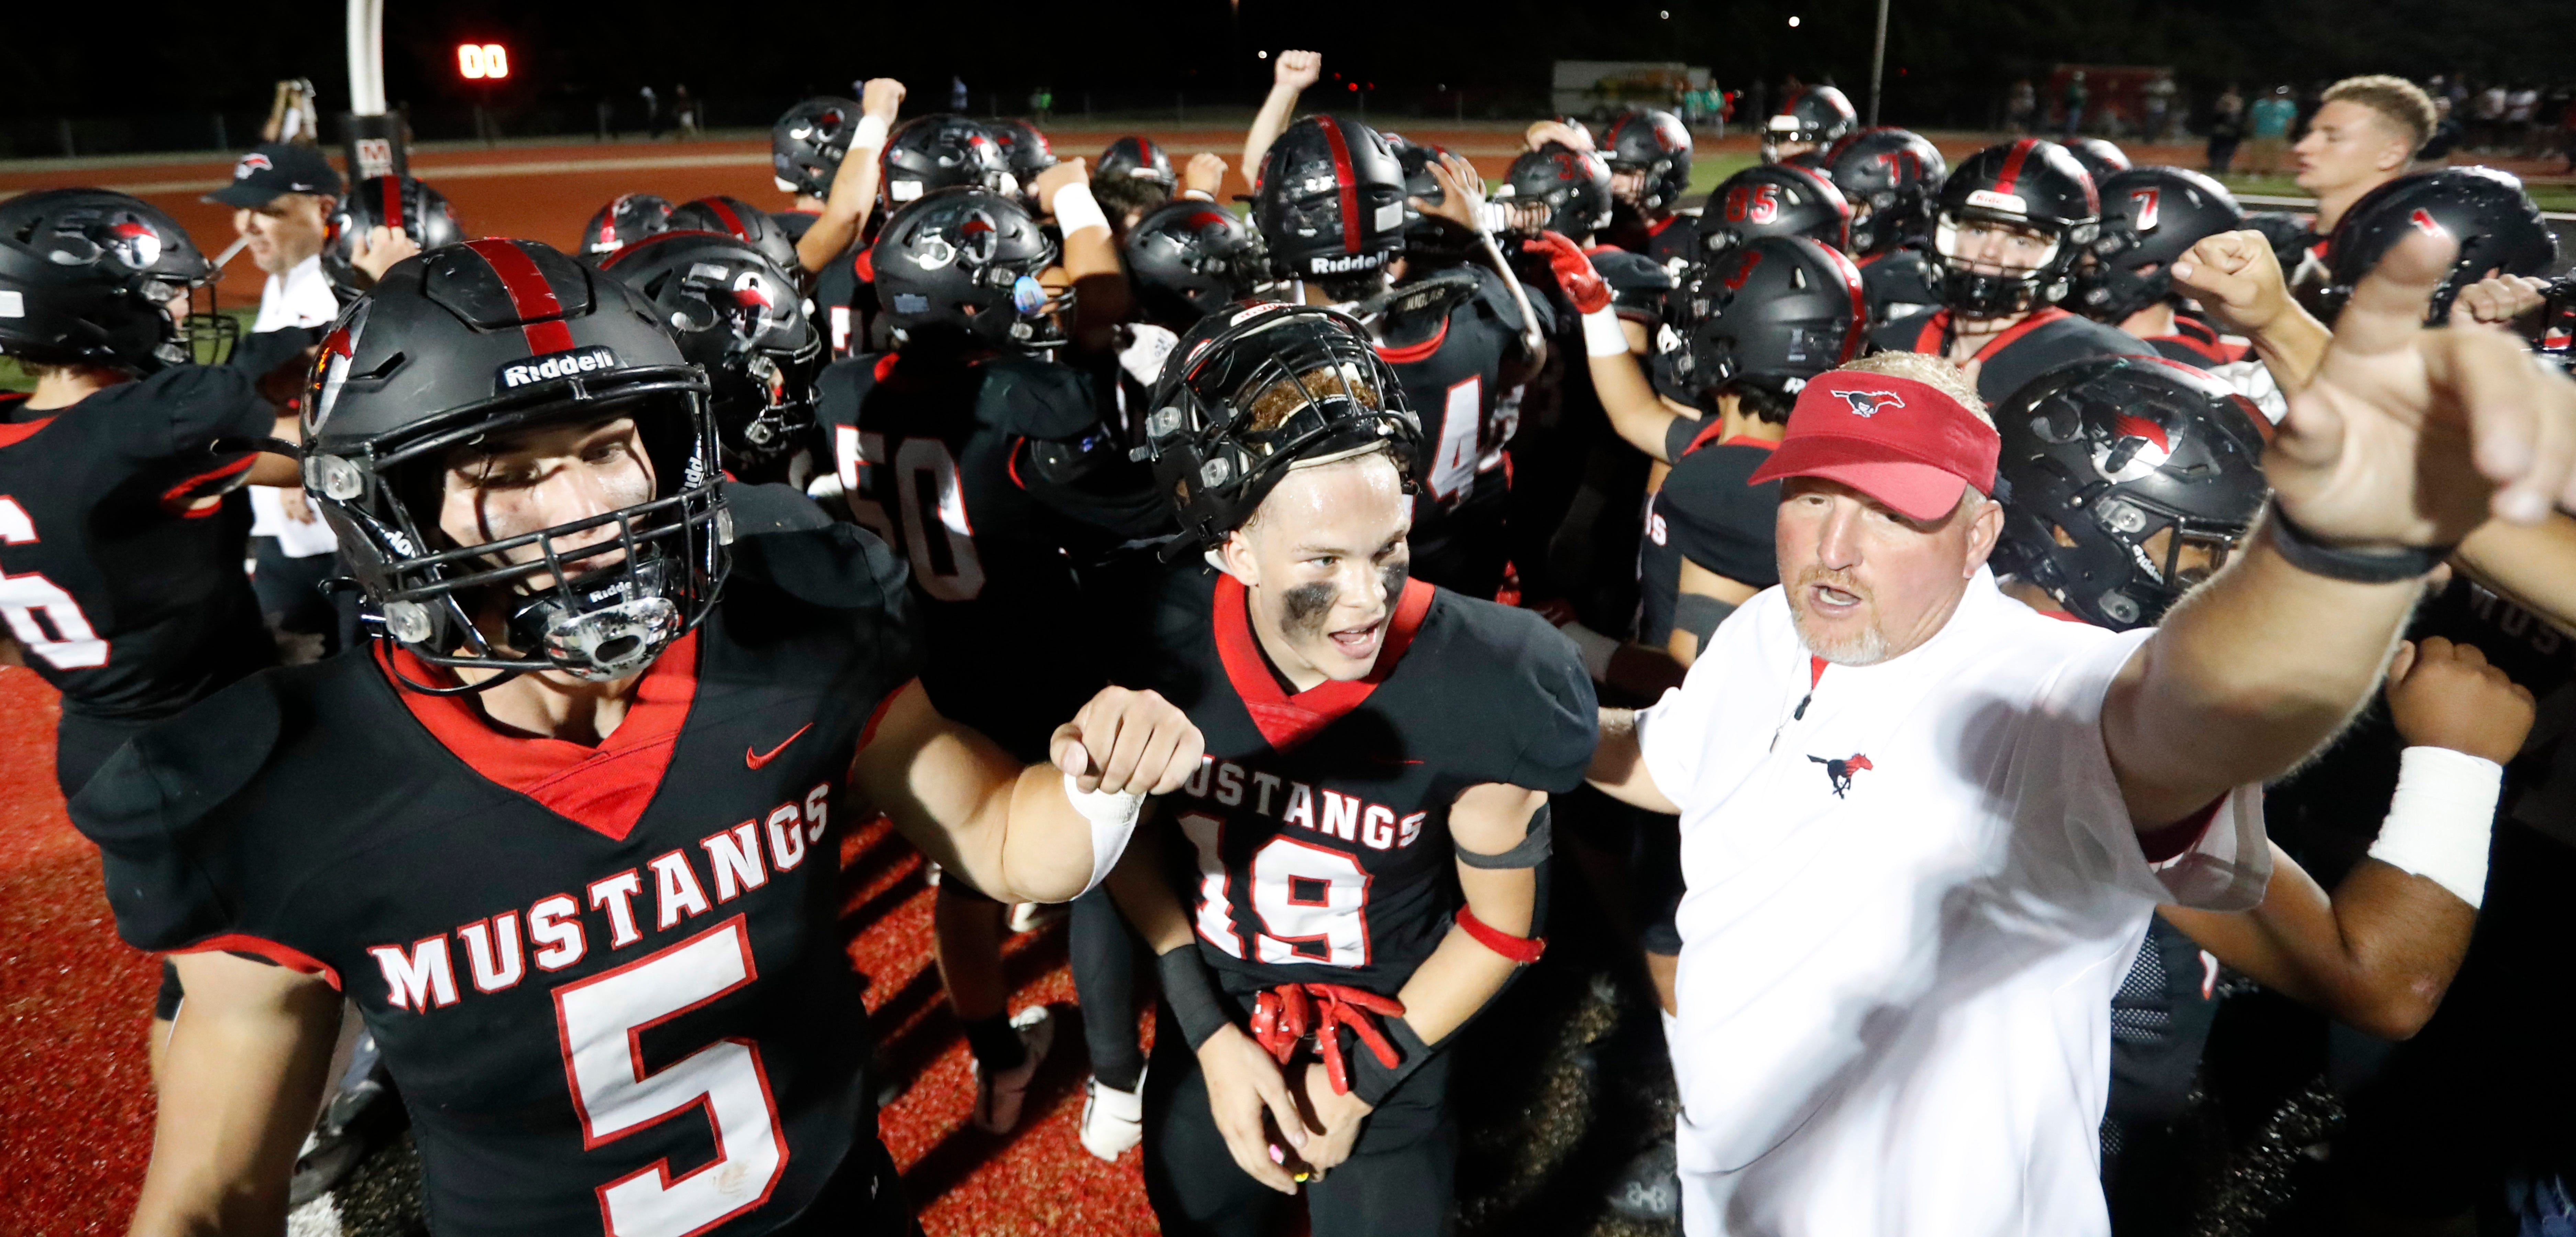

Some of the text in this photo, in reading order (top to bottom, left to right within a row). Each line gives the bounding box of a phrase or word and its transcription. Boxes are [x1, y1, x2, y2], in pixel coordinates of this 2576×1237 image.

[458, 44, 508, 79] 00
[1725, 183, 1781, 224] 85
[2132, 186, 2160, 231] 7
[1311, 250, 1389, 274] Riddell
[505, 349, 614, 387] Riddell
[835, 424, 986, 601] 50
[589, 581, 632, 603] Ridde
[1184, 753, 1428, 851] USTANGS
[367, 781, 830, 1013] MUSTANGS
[1177, 810, 1375, 969] 19
[551, 913, 790, 1237] 5
